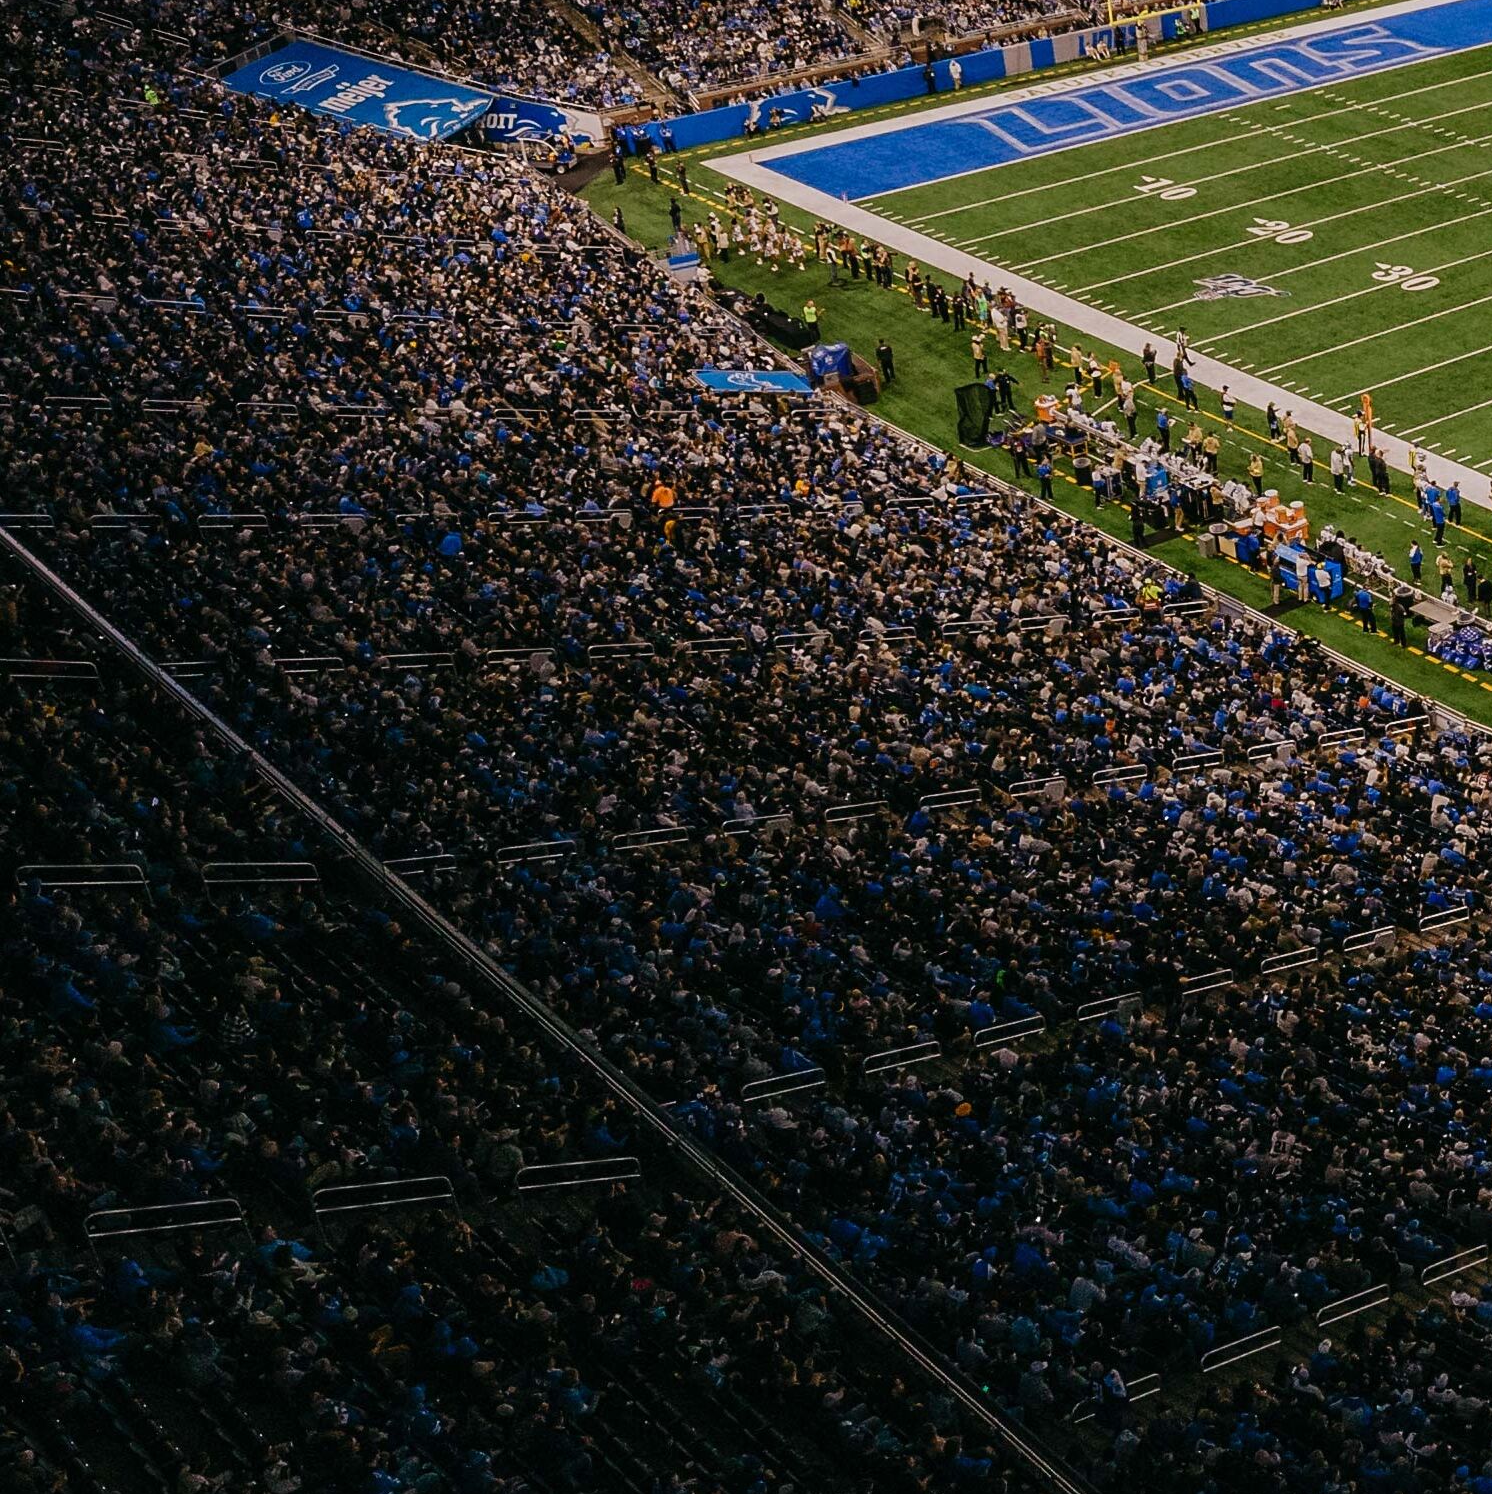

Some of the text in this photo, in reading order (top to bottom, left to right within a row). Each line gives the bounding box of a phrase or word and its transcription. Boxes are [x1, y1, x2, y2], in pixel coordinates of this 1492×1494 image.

[272, 66, 305, 82] Ford
[318, 73, 396, 113] meijer
[960, 25, 1455, 155] LIONS
[1134, 179, 1197, 201] 10
[1247, 220, 1314, 245] 20
[1372, 264, 1440, 292] 30
